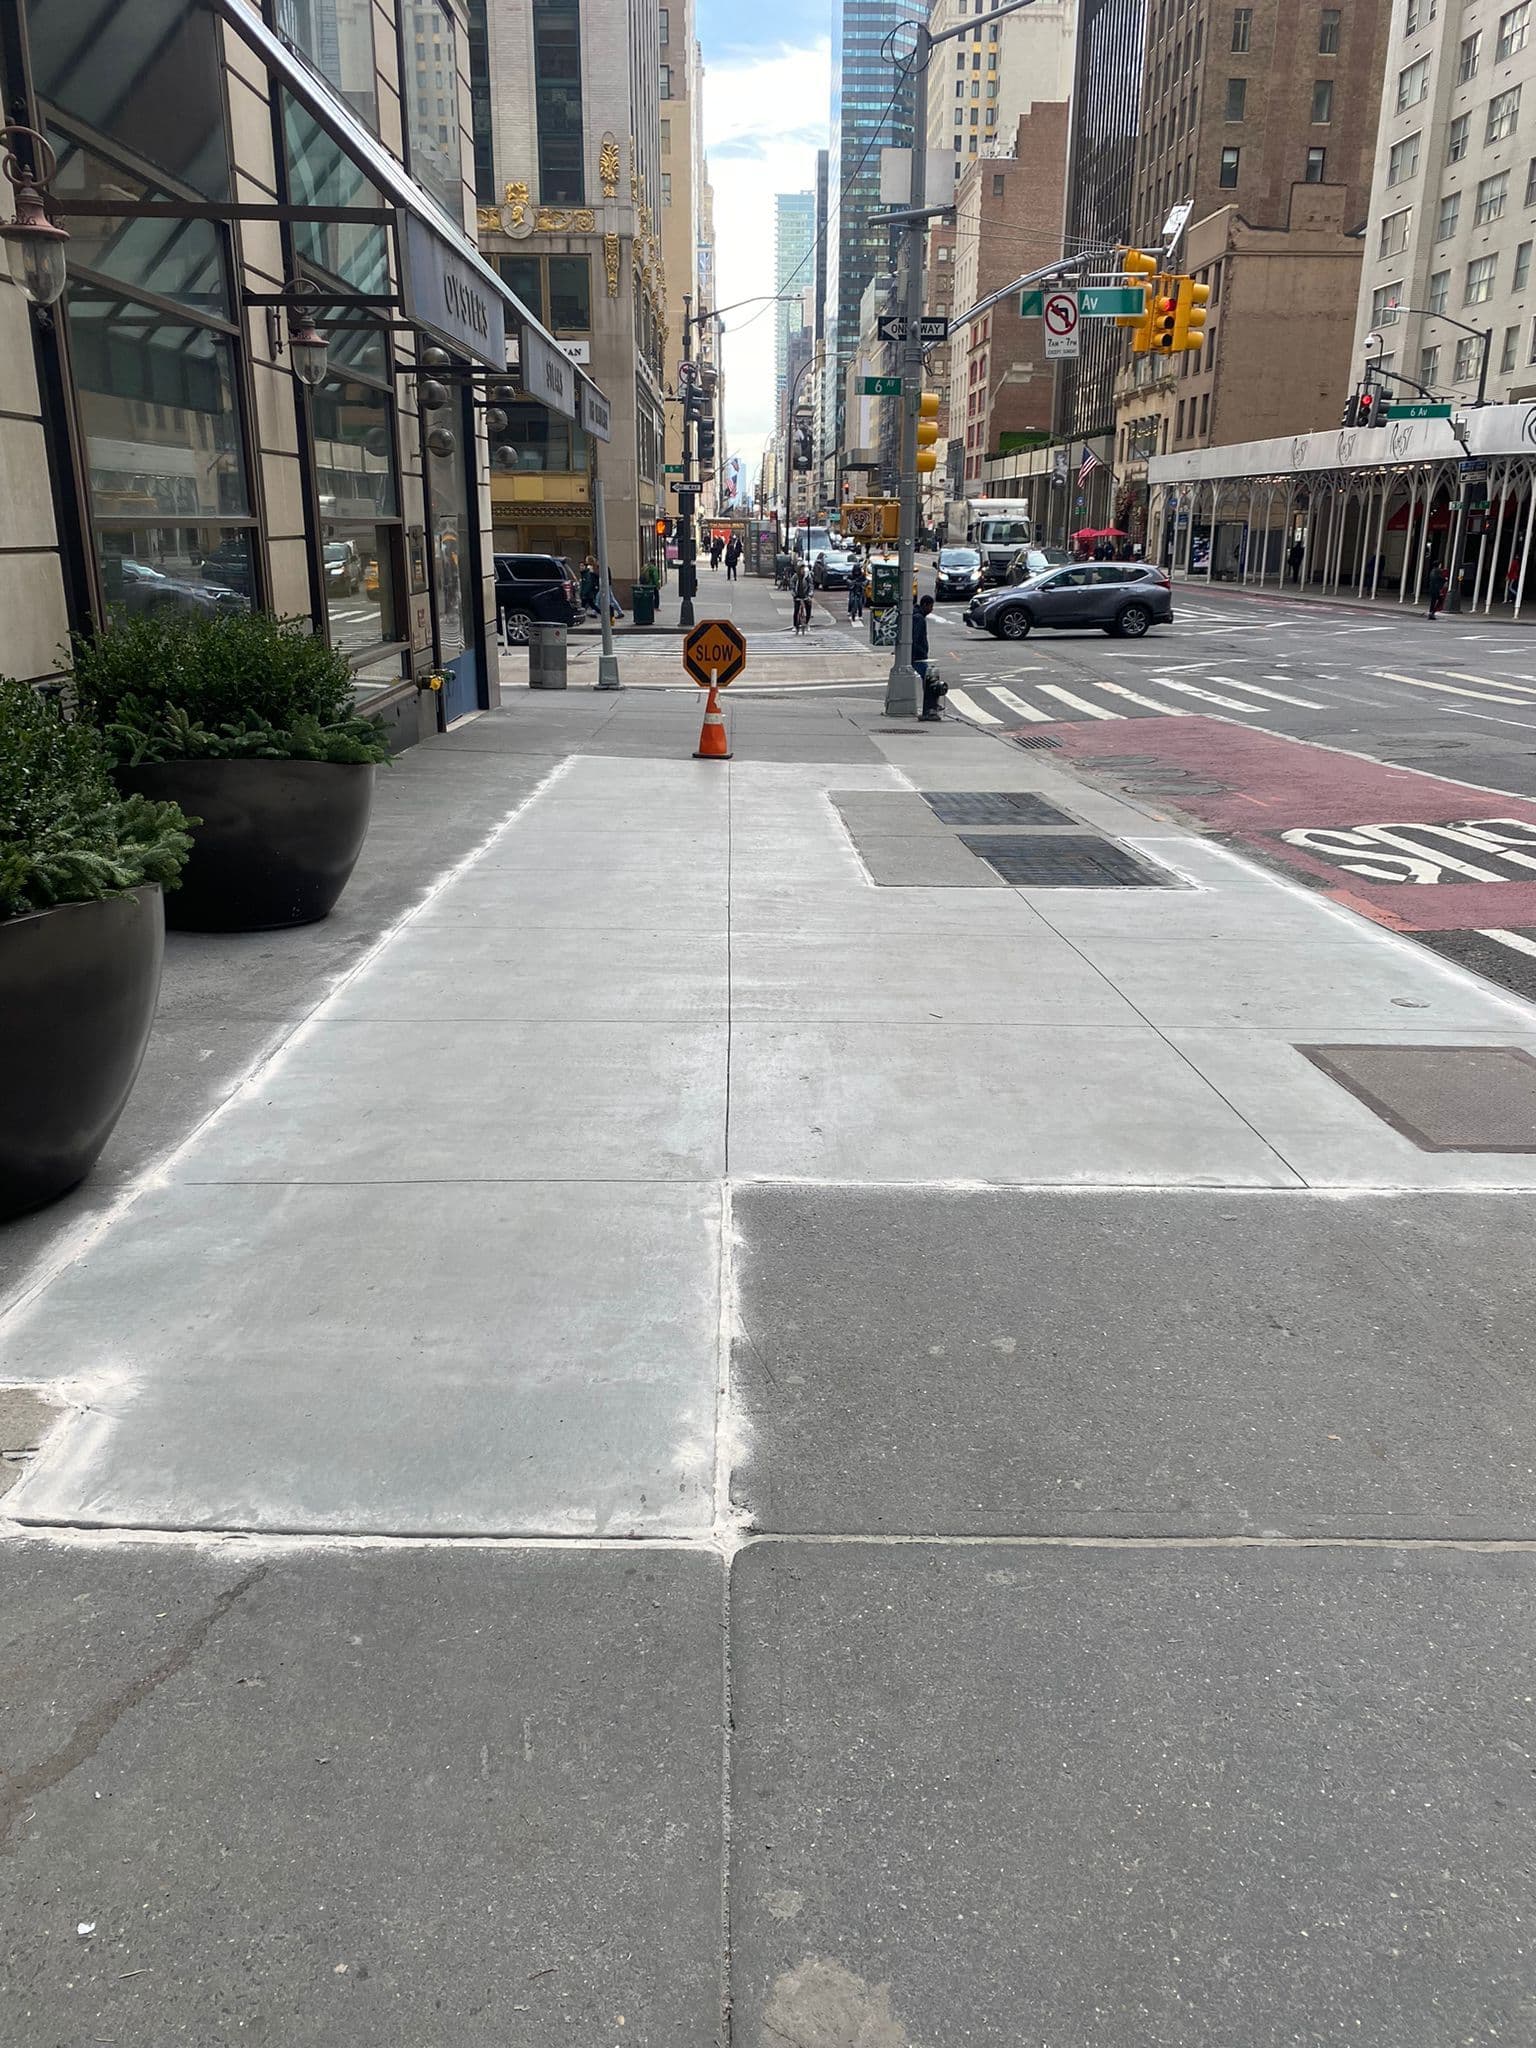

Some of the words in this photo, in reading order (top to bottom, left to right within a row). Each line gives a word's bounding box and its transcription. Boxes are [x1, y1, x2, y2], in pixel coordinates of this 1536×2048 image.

[443, 273, 488, 339] OYSTERS
[1081, 294, 1099, 311] Av
[891, 324, 908, 334] ON
[920, 325, 941, 334] WAY
[875, 380, 883, 393] 6
[1410, 407, 1416, 416] 6
[1418, 407, 1428, 416] Av
[696, 645, 733, 661] SLOW
